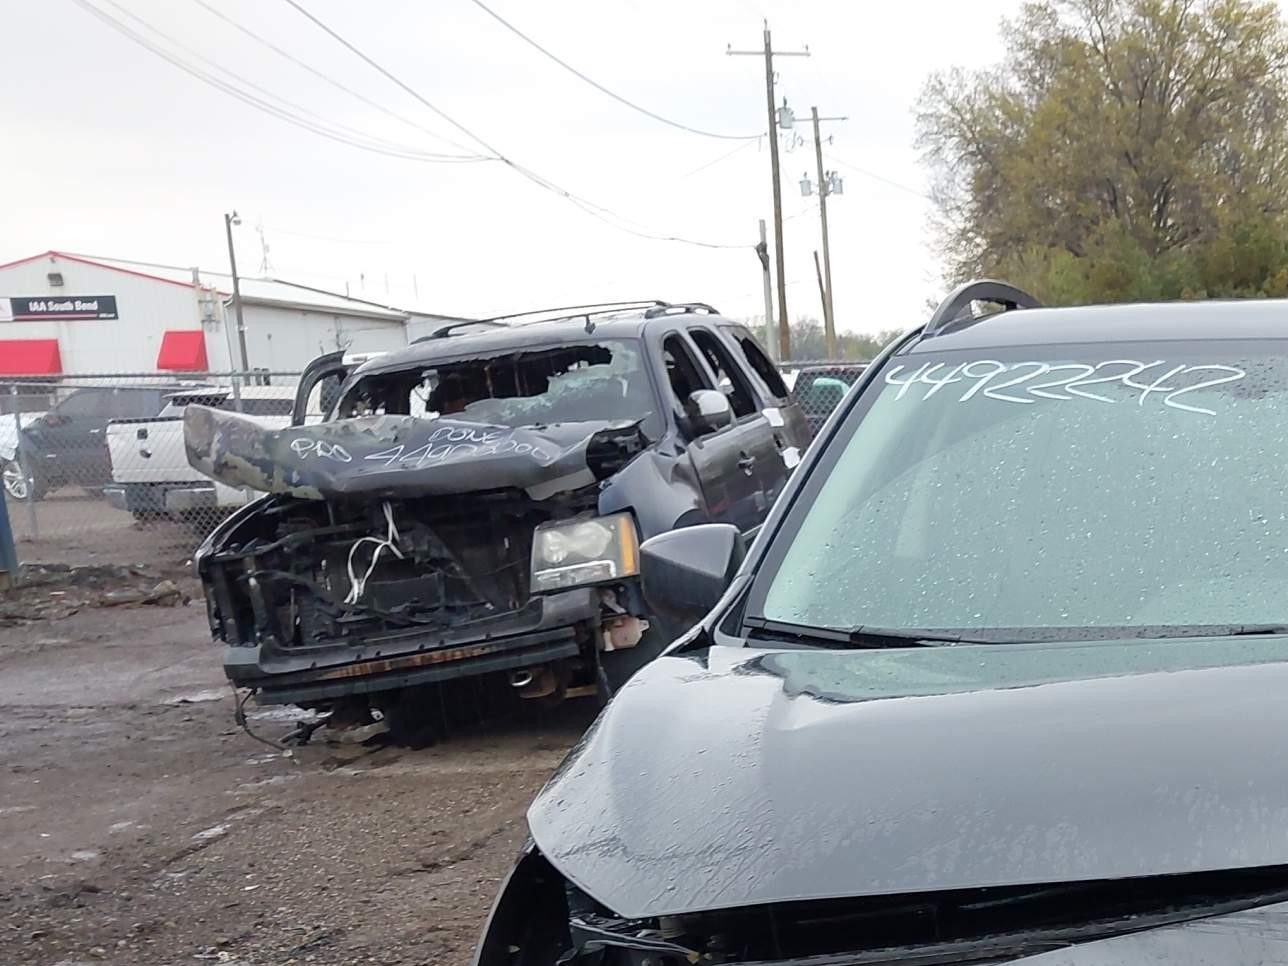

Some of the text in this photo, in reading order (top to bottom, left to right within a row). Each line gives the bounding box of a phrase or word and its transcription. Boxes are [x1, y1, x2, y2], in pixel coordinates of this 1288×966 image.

[28, 301, 47, 312] IAA
[74, 300, 98, 311] Bend
[885, 360, 1246, 415] 44922242
